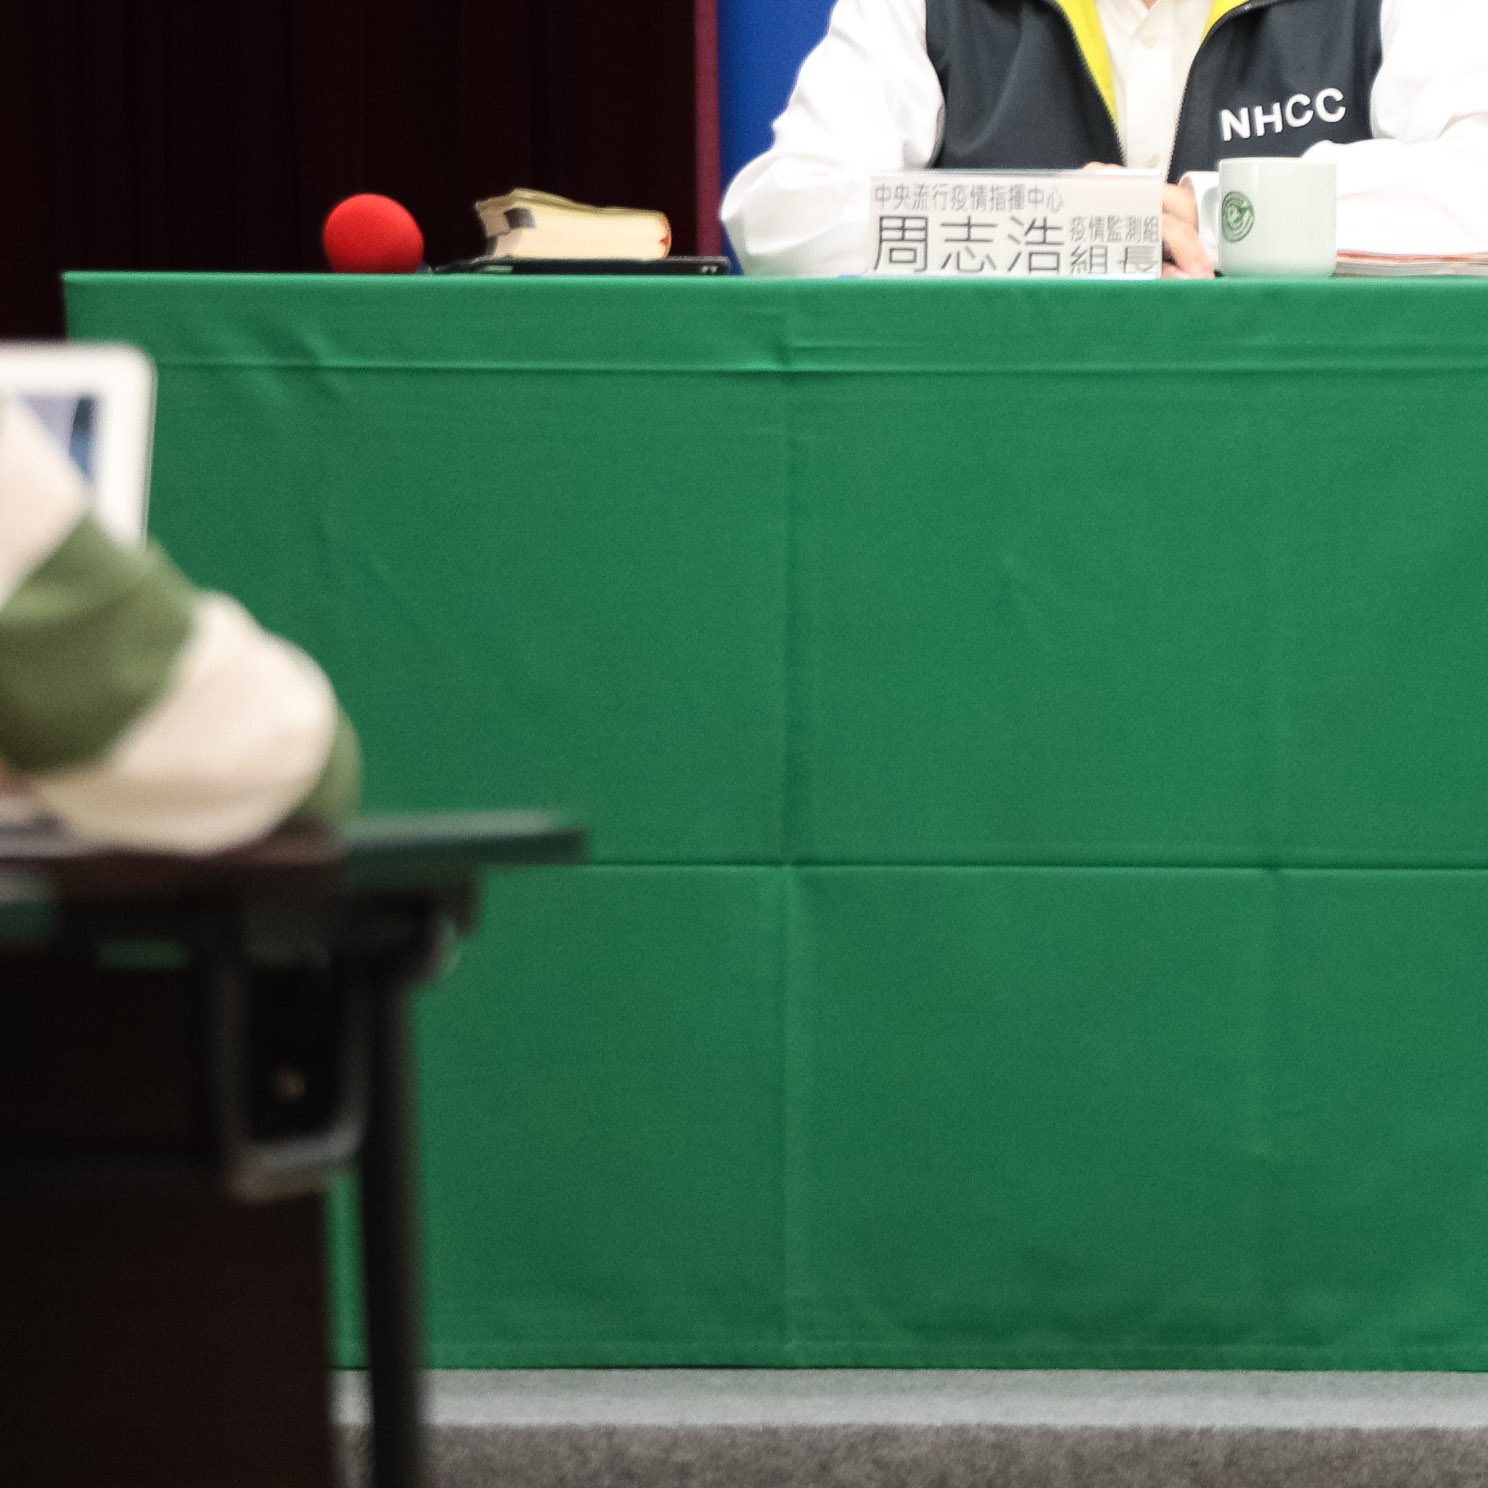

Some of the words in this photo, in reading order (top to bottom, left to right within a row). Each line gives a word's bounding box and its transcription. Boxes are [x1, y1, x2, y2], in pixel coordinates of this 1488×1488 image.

[1220, 87, 1347, 142] NHCC
[874, 183, 1064, 213] 中央流行疫情指揮中心
[873, 215, 1065, 273] 周志浩
[1069, 244, 1160, 275] 組長
